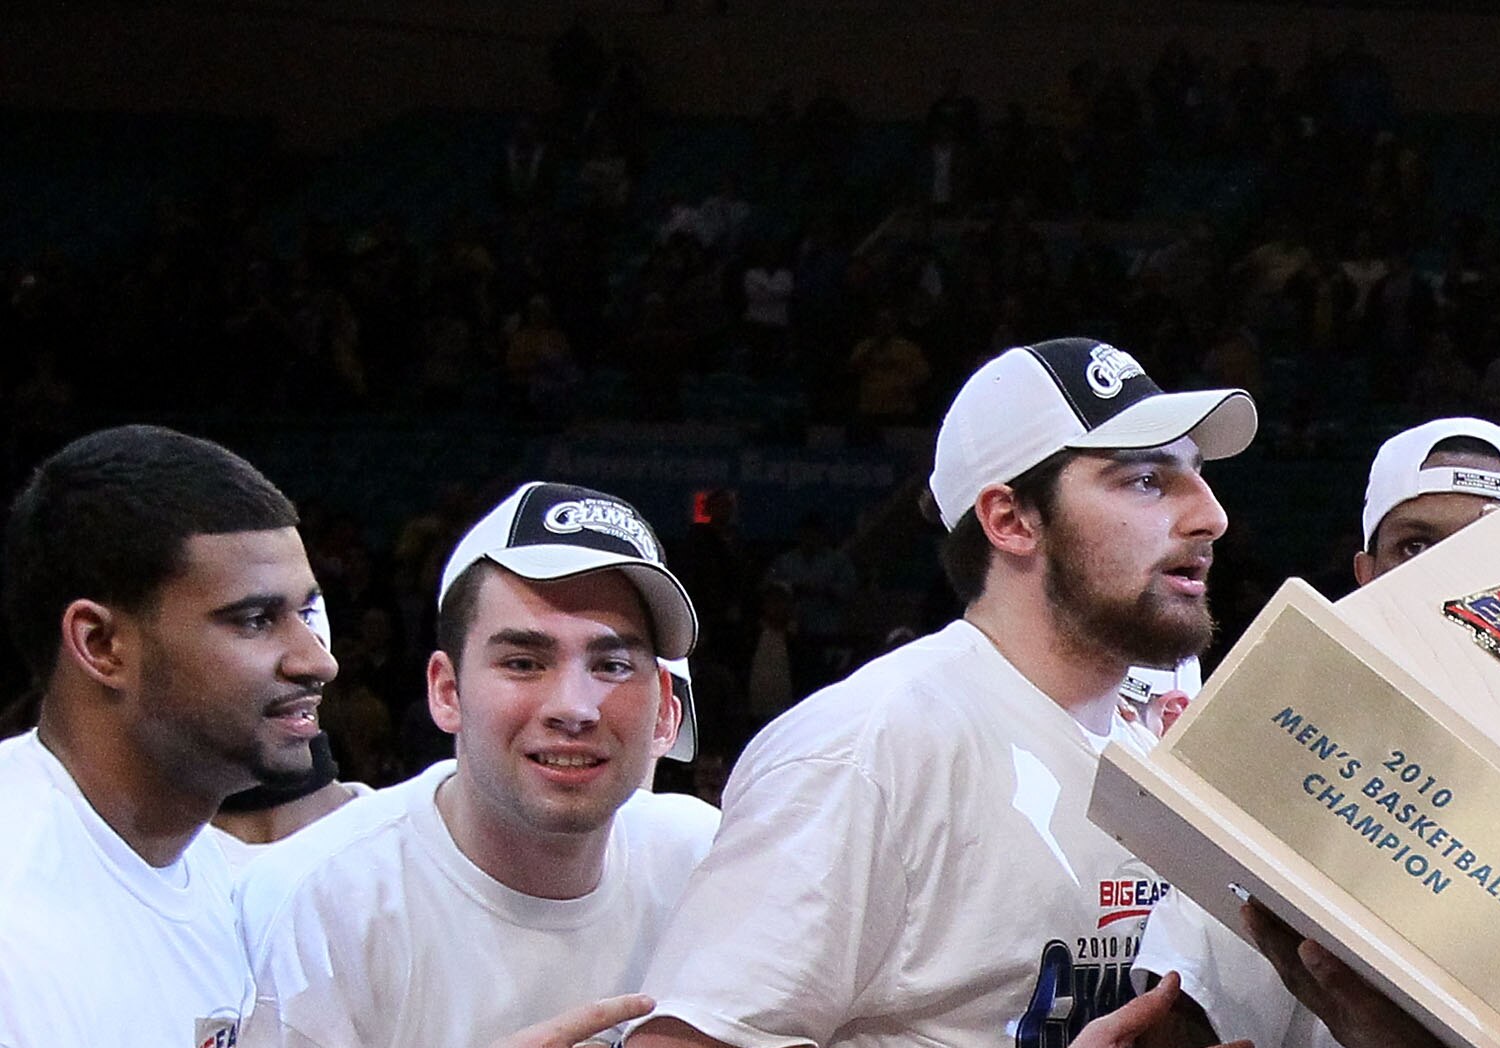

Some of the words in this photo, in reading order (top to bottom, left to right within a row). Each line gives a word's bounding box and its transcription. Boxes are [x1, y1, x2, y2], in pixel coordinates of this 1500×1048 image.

[1272, 706, 1362, 779] MEN'S
[1383, 750, 1453, 808] 2010
[1302, 773, 1451, 894] CHAMPION
[1077, 937, 1118, 959] 2010
